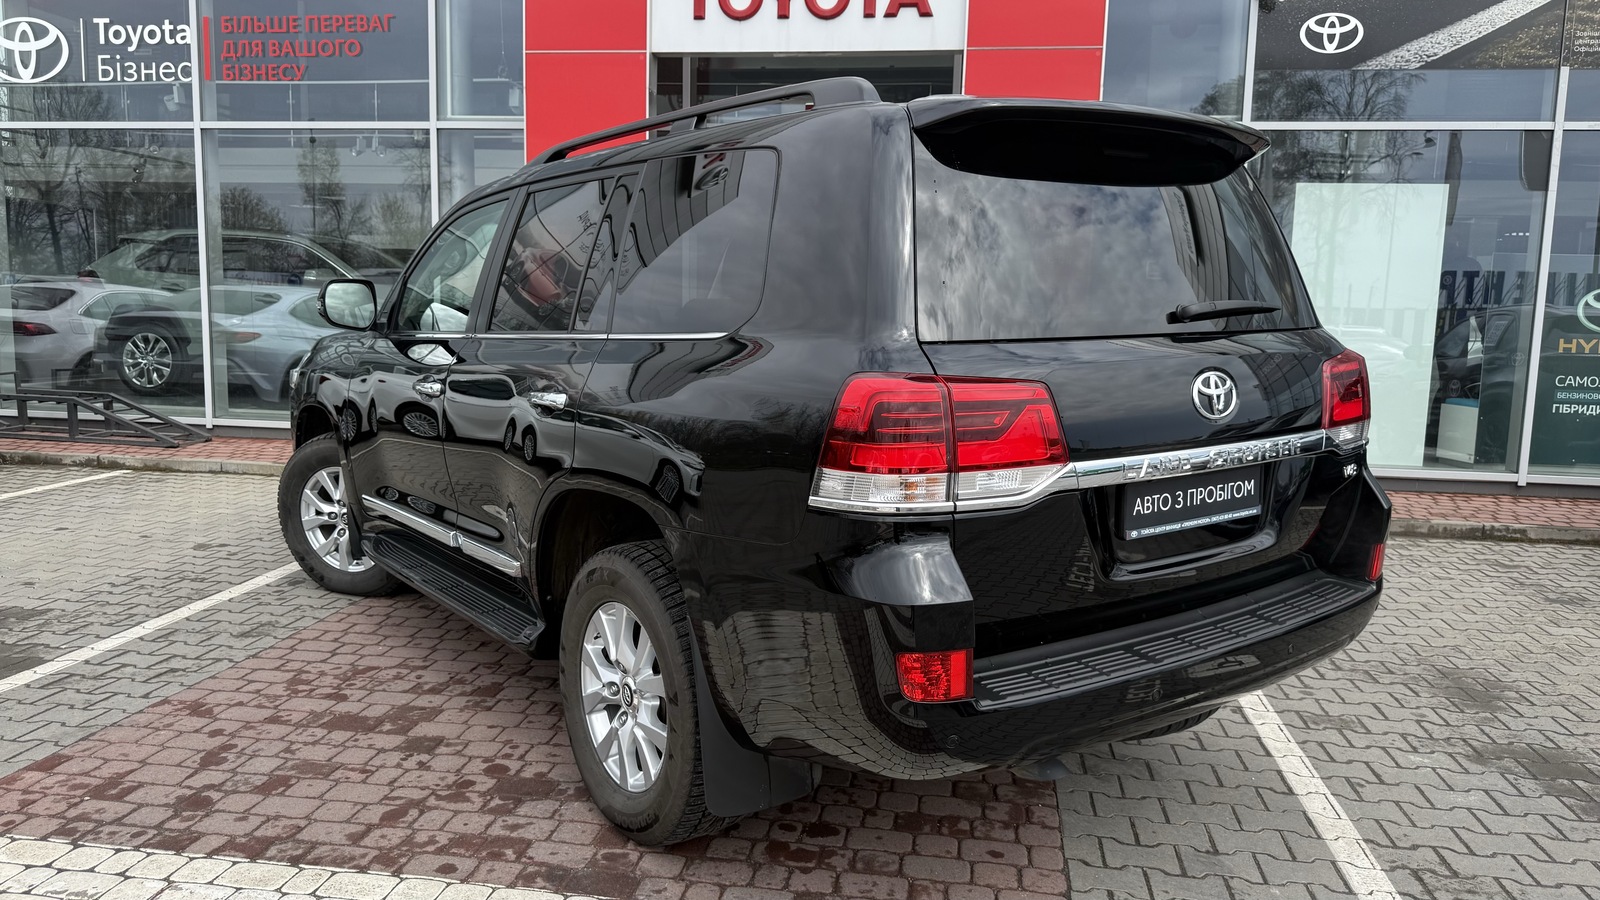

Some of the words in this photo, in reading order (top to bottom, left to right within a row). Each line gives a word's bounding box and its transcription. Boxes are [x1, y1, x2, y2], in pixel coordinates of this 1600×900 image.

[220, 15, 302, 34] БІЛЬШЕ
[305, 13, 395, 33] ПЕРЕВАГ
[93, 18, 191, 53] Toyota
[220, 39, 267, 61] ДЛЯ
[269, 38, 363, 58] ВАШОГО
[98, 55, 192, 83] Бізнес
[222, 63, 308, 82] БІЗНЕСУ
[1558, 338, 1600, 354] HY
[1555, 375, 1600, 388] САМО
[1557, 391, 1600, 400] БЕНЗИНОВ
[1121, 453, 1192, 481] LAND
[1132, 492, 1172, 516] АВТО
[1187, 478, 1256, 507] ПРОБІГОМ
